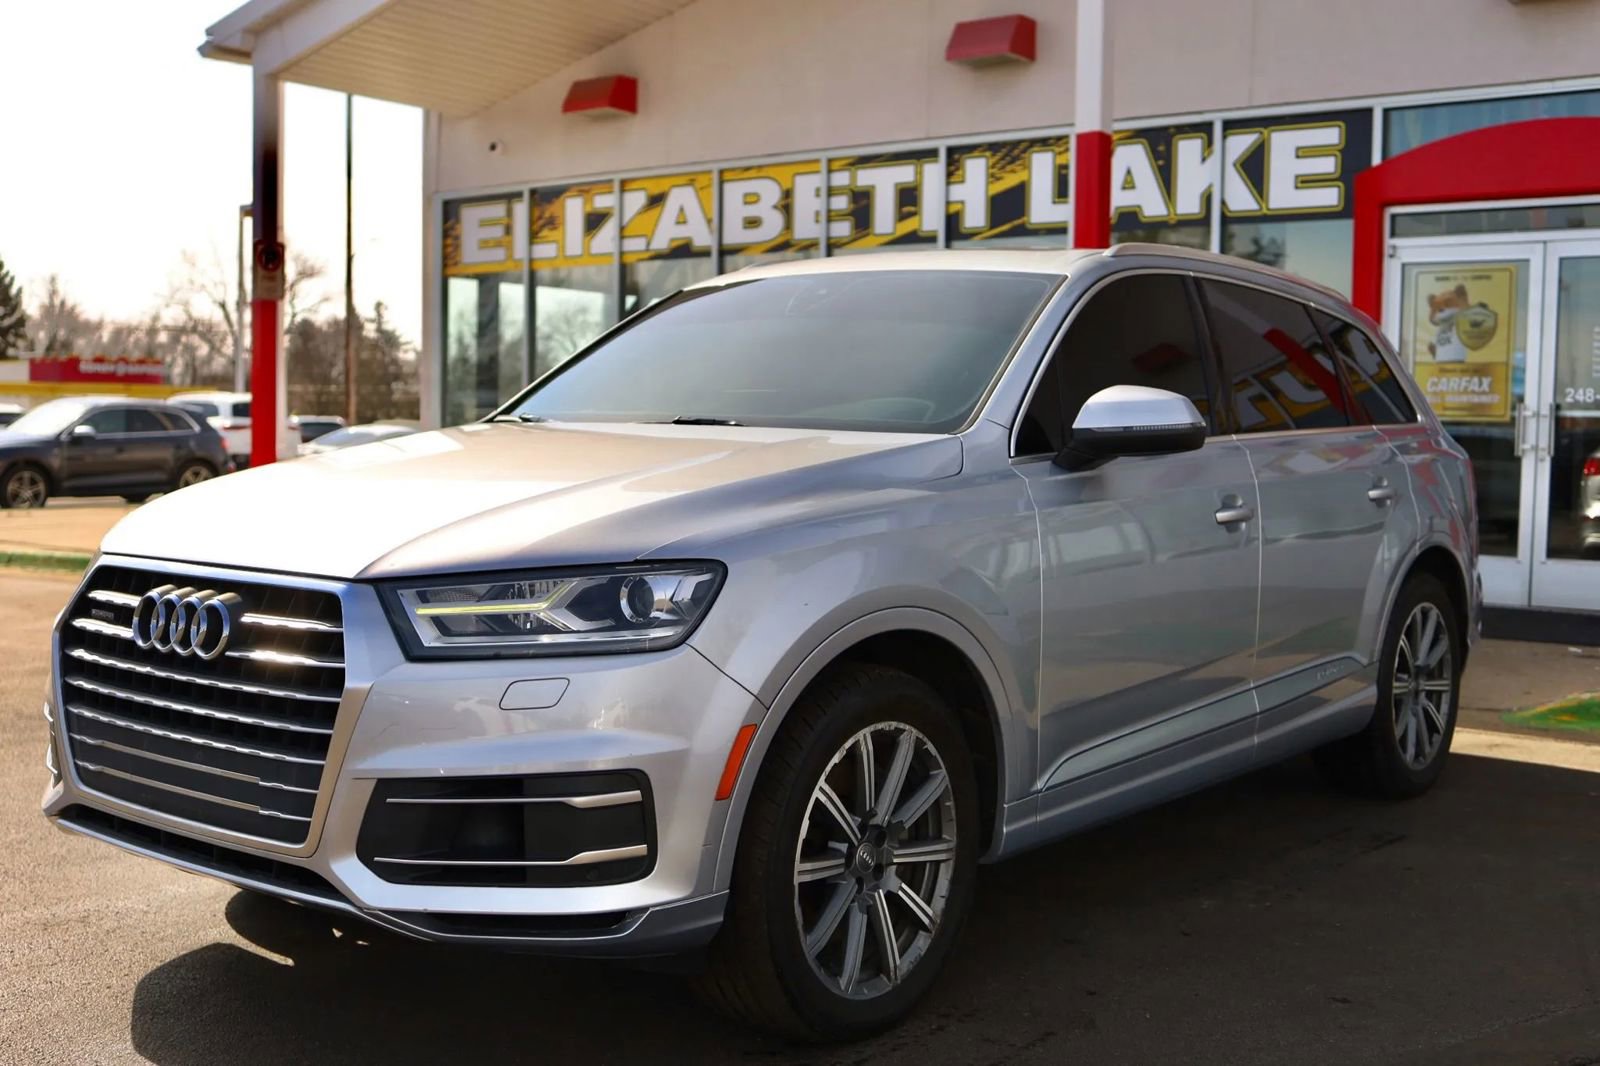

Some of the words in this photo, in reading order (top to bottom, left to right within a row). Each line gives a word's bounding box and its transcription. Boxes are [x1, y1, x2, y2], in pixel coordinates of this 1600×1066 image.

[459, 154, 989, 264] ELIZABETH
[1027, 122, 1345, 229] LAKE
[1427, 376, 1493, 393] CARFAX
